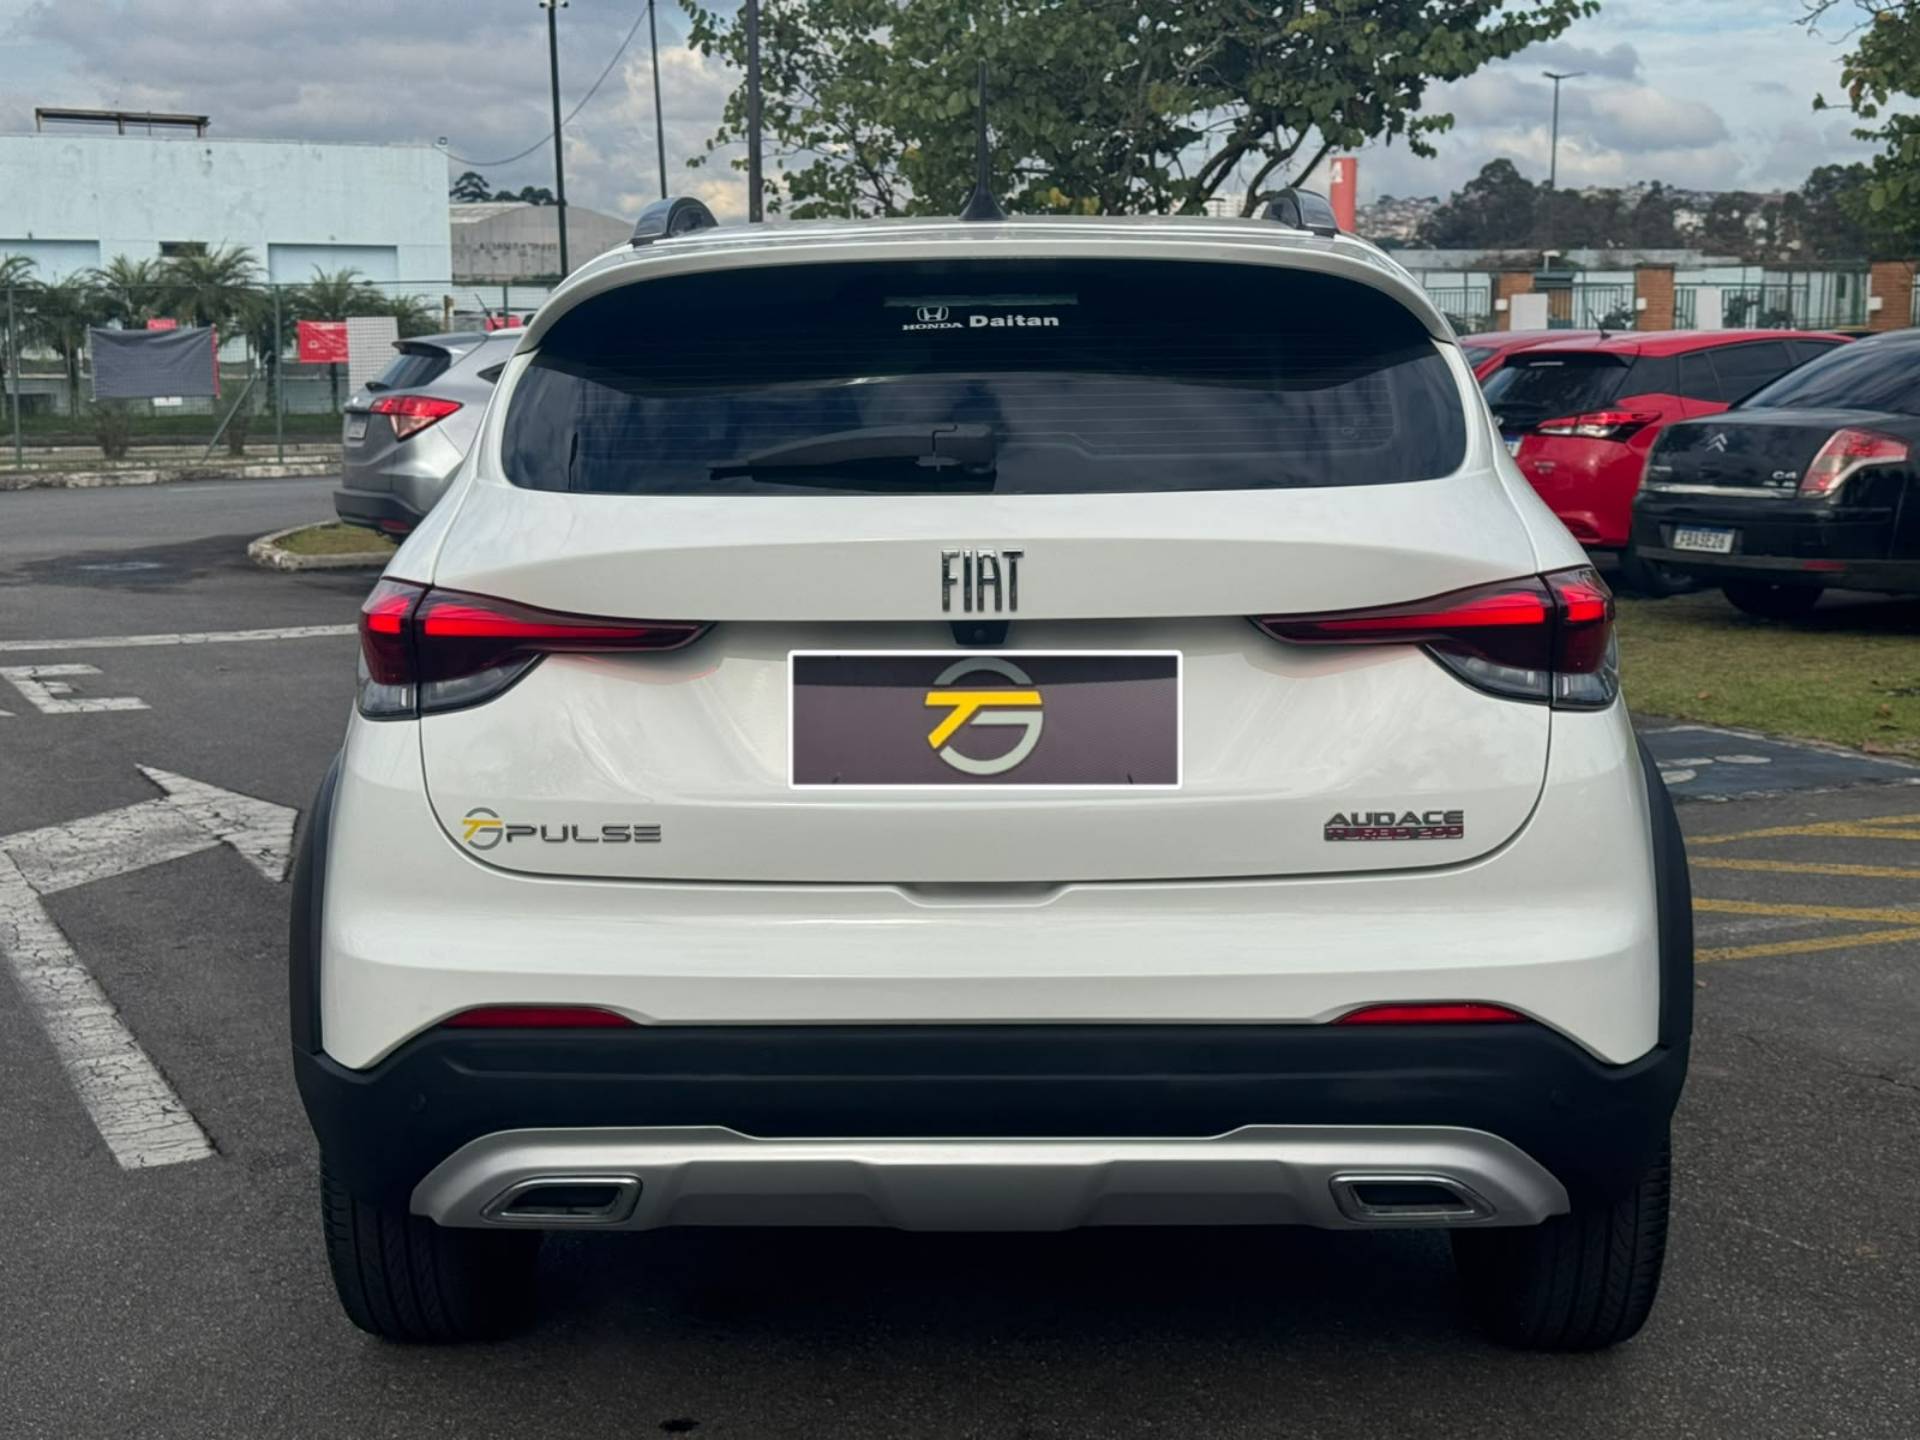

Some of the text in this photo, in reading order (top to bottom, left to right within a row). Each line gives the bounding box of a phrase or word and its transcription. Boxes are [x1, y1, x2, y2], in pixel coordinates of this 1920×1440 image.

[902, 315, 1060, 331] HONDA Daitan
[941, 549, 1024, 613] FIAT
[1324, 810, 1464, 827] AUDACE
[505, 823, 662, 843] PULSE
